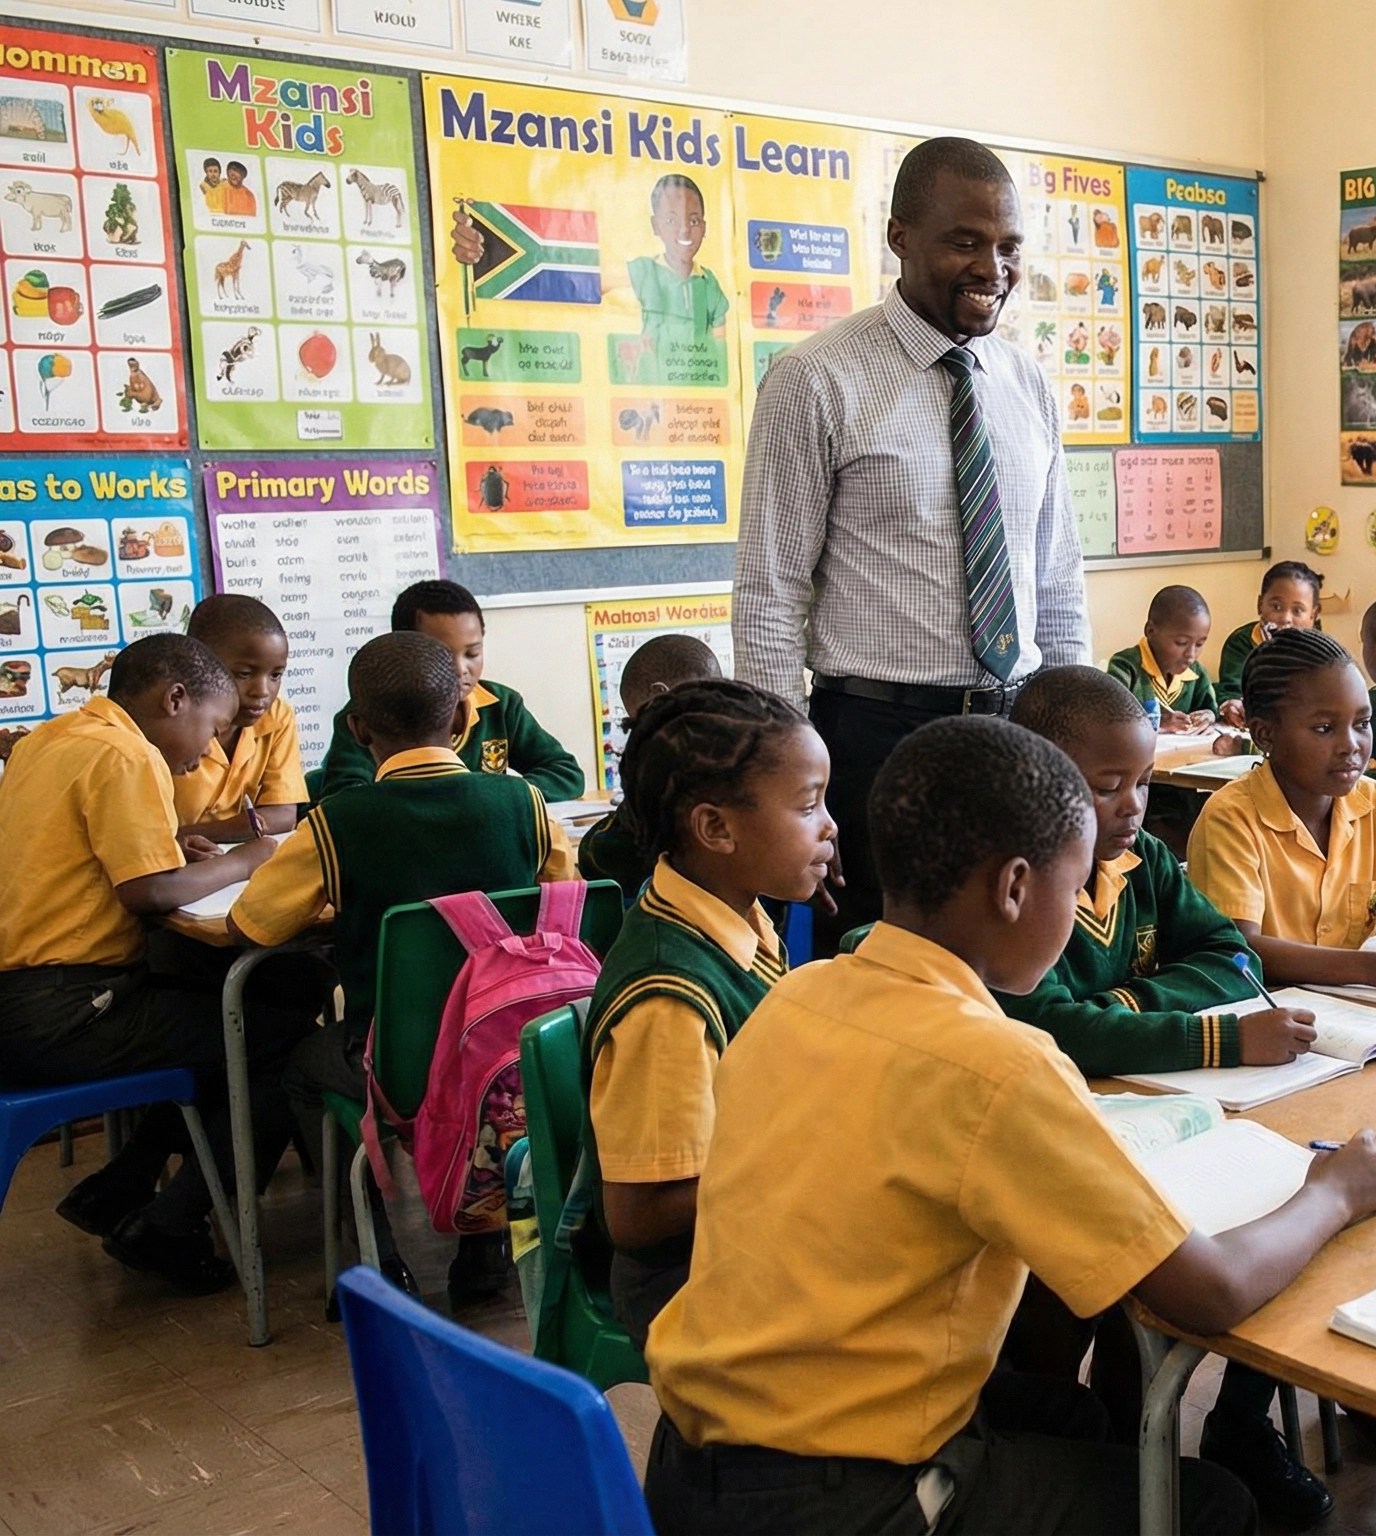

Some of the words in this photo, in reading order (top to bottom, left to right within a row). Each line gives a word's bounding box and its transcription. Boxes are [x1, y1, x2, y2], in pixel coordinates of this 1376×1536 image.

[0, 44, 147, 84] ommen
[206, 59, 373, 117] Mzansi
[244, 107, 343, 155] Kids
[440, 88, 614, 155] Mzansi
[628, 112, 721, 167] Kids
[735, 125, 850, 181] Learn
[1062, 167, 1111, 197] Fives
[1345, 177, 1375, 201] BIG
[45, 473, 82, 500] to
[89, 470, 187, 499] Works
[216, 470, 335, 504] Primary
[343, 469, 430, 496] Words
